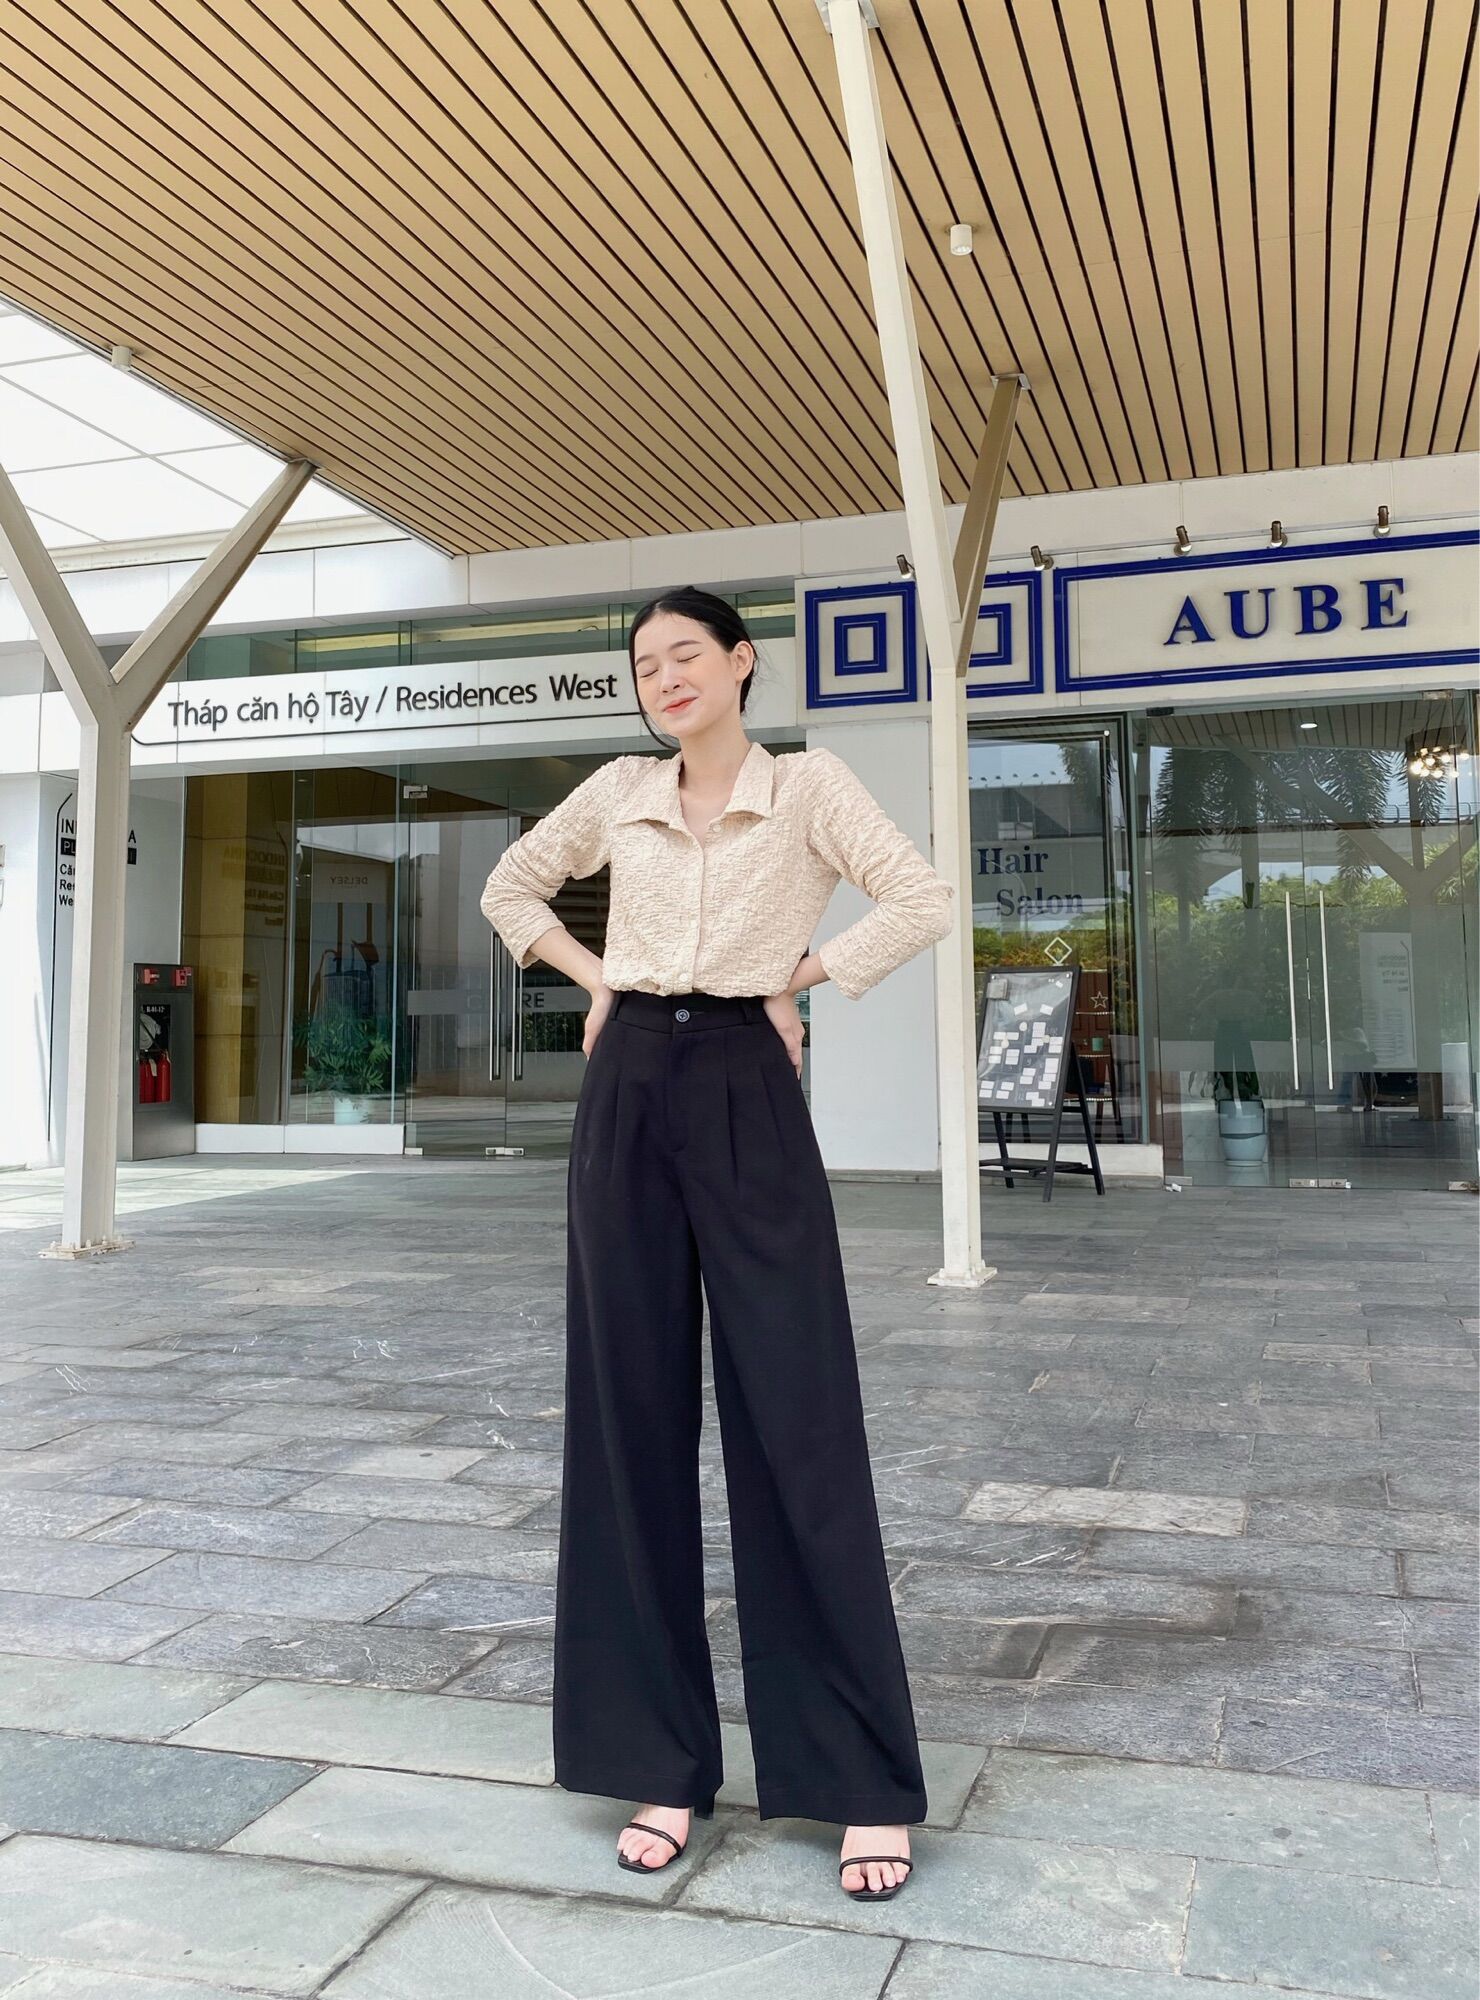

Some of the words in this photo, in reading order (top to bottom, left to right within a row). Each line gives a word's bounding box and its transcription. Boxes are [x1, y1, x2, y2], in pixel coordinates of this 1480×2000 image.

[1163, 578, 1408, 645] AUBE
[167, 701, 228, 731] Tháp
[236, 697, 278, 722] căn
[287, 693, 319, 724] hộ
[325, 690, 369, 722] Tây
[375, 686, 388, 713] /
[396, 680, 537, 713] Residences
[549, 672, 618, 700] West
[977, 845, 1049, 875] Hair
[996, 887, 1084, 917] Salon
